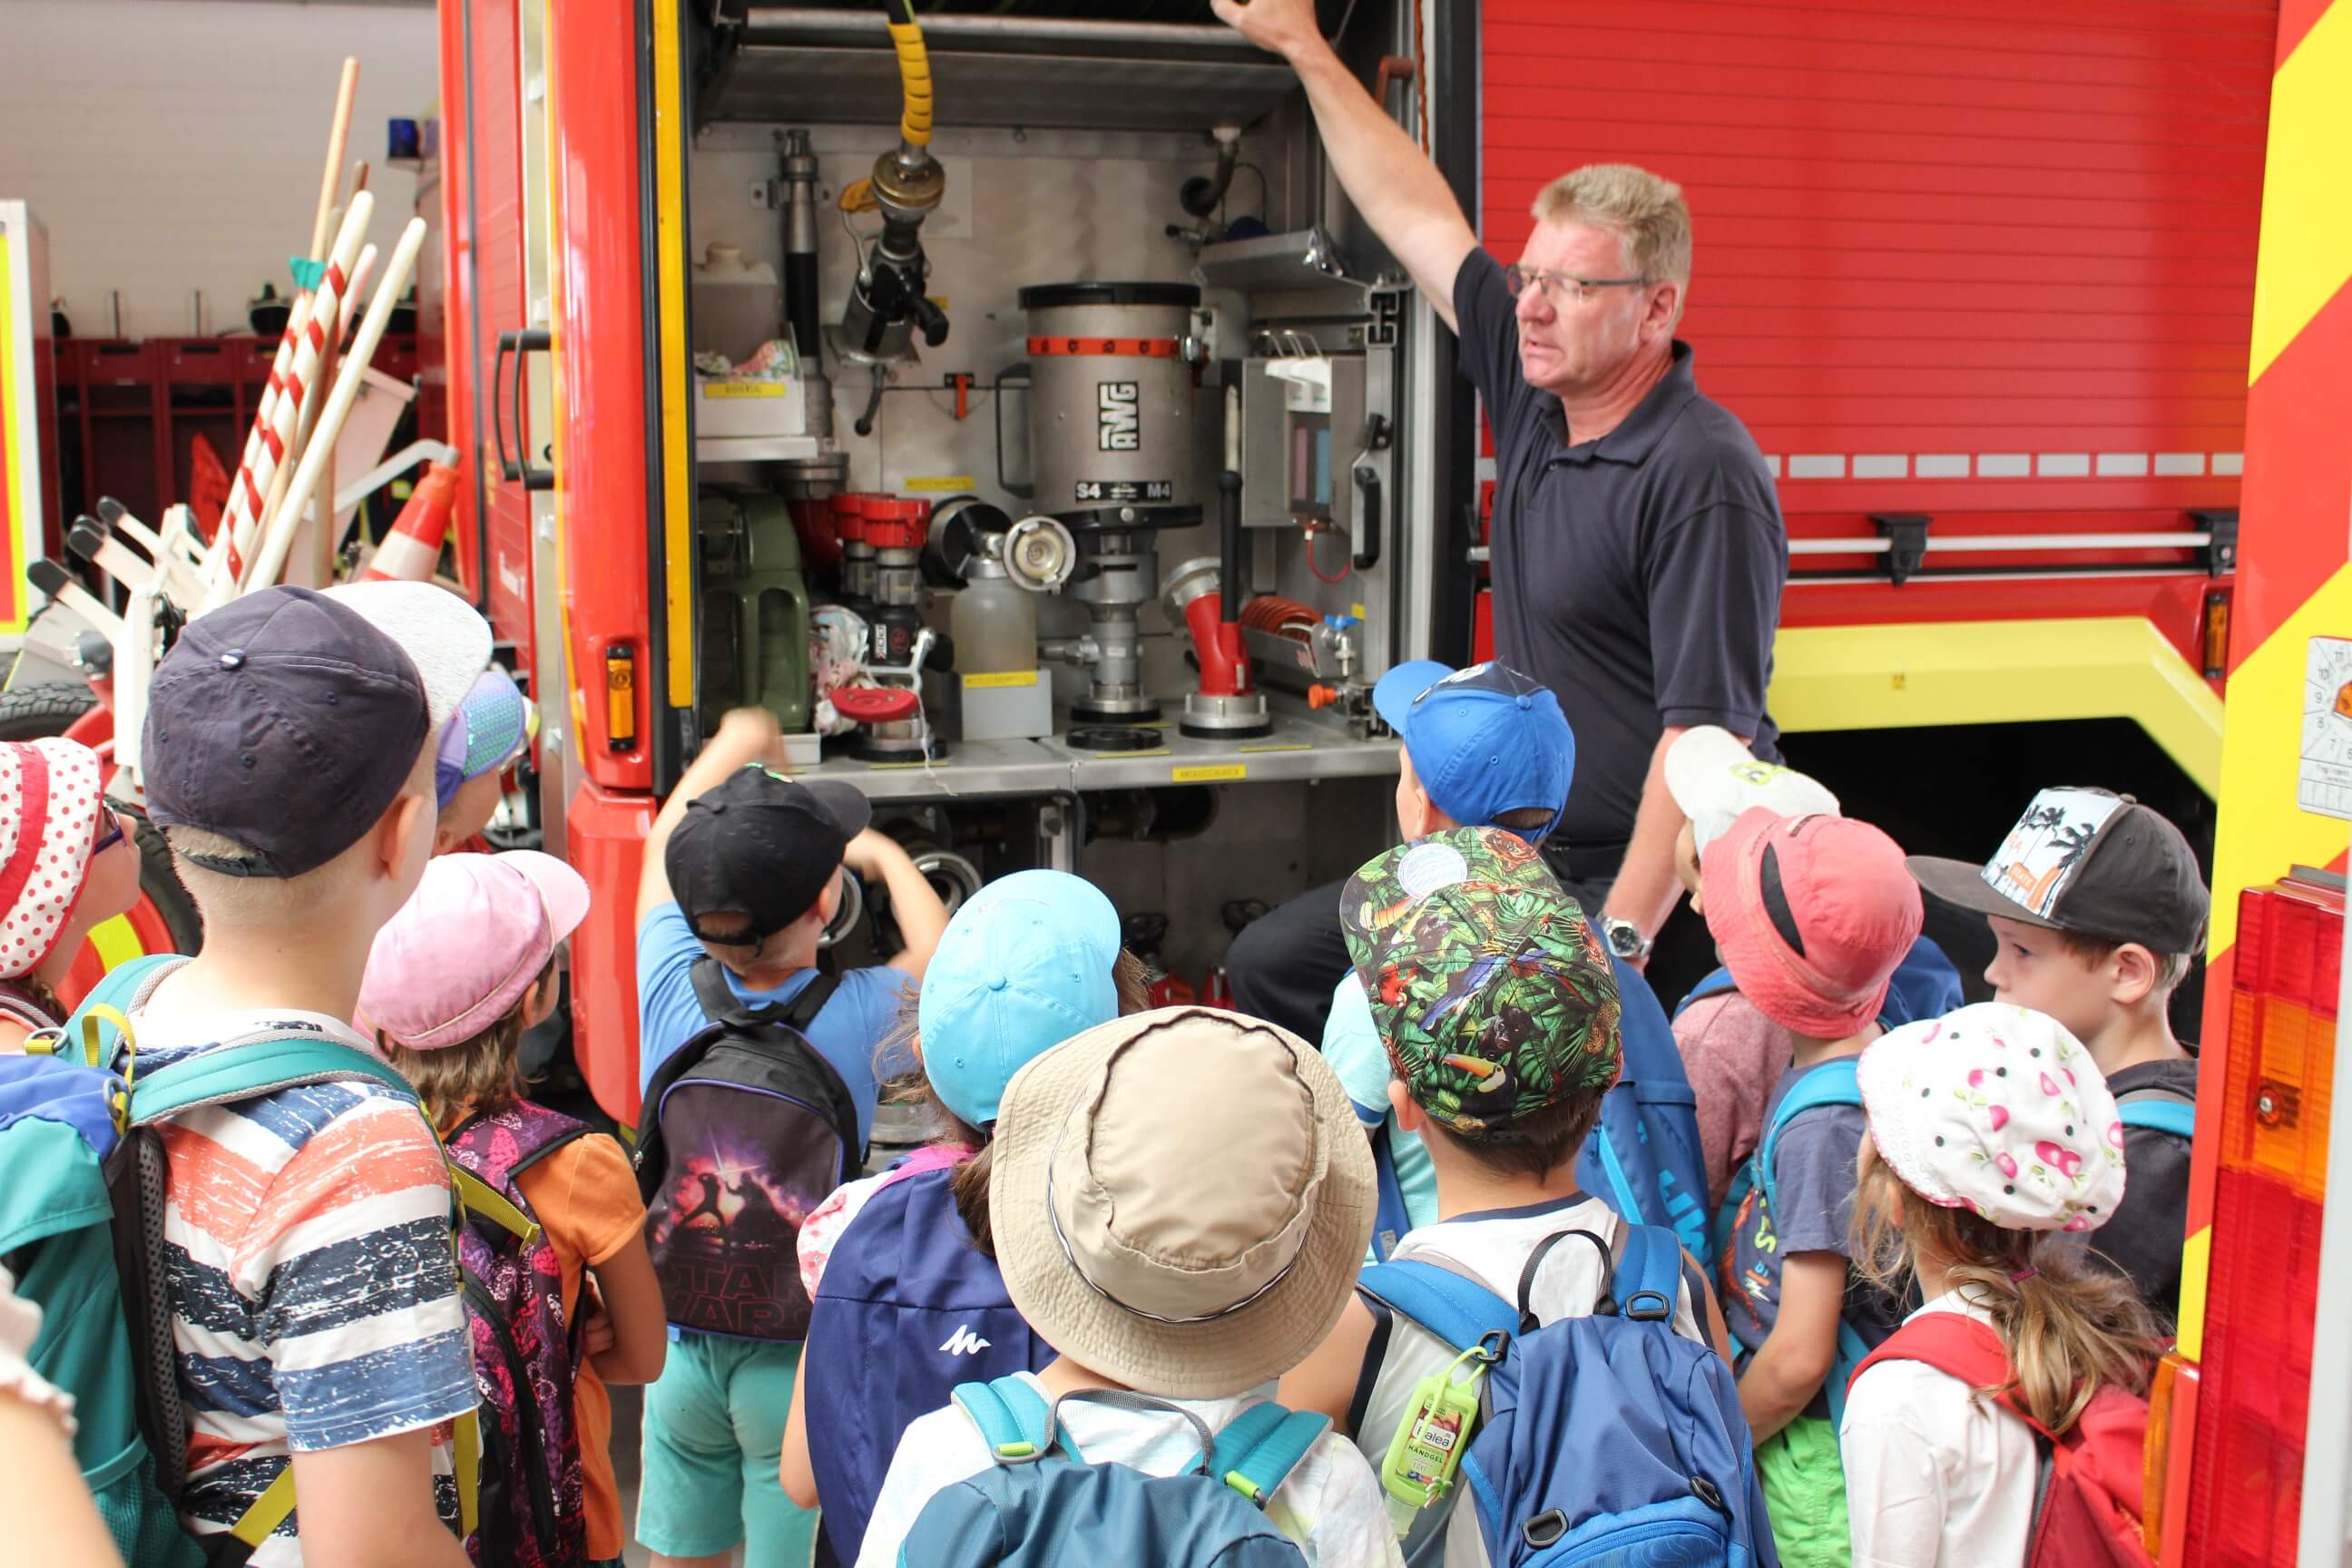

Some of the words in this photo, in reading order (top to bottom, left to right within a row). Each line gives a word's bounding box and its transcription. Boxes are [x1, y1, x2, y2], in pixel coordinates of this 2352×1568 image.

[1099, 383, 1138, 450] AWG
[1076, 482, 1102, 499] S4
[1146, 482, 1171, 498] M4
[668, 1292, 809, 1336] AR
[1407, 1444, 1445, 1464] HANDGEL
